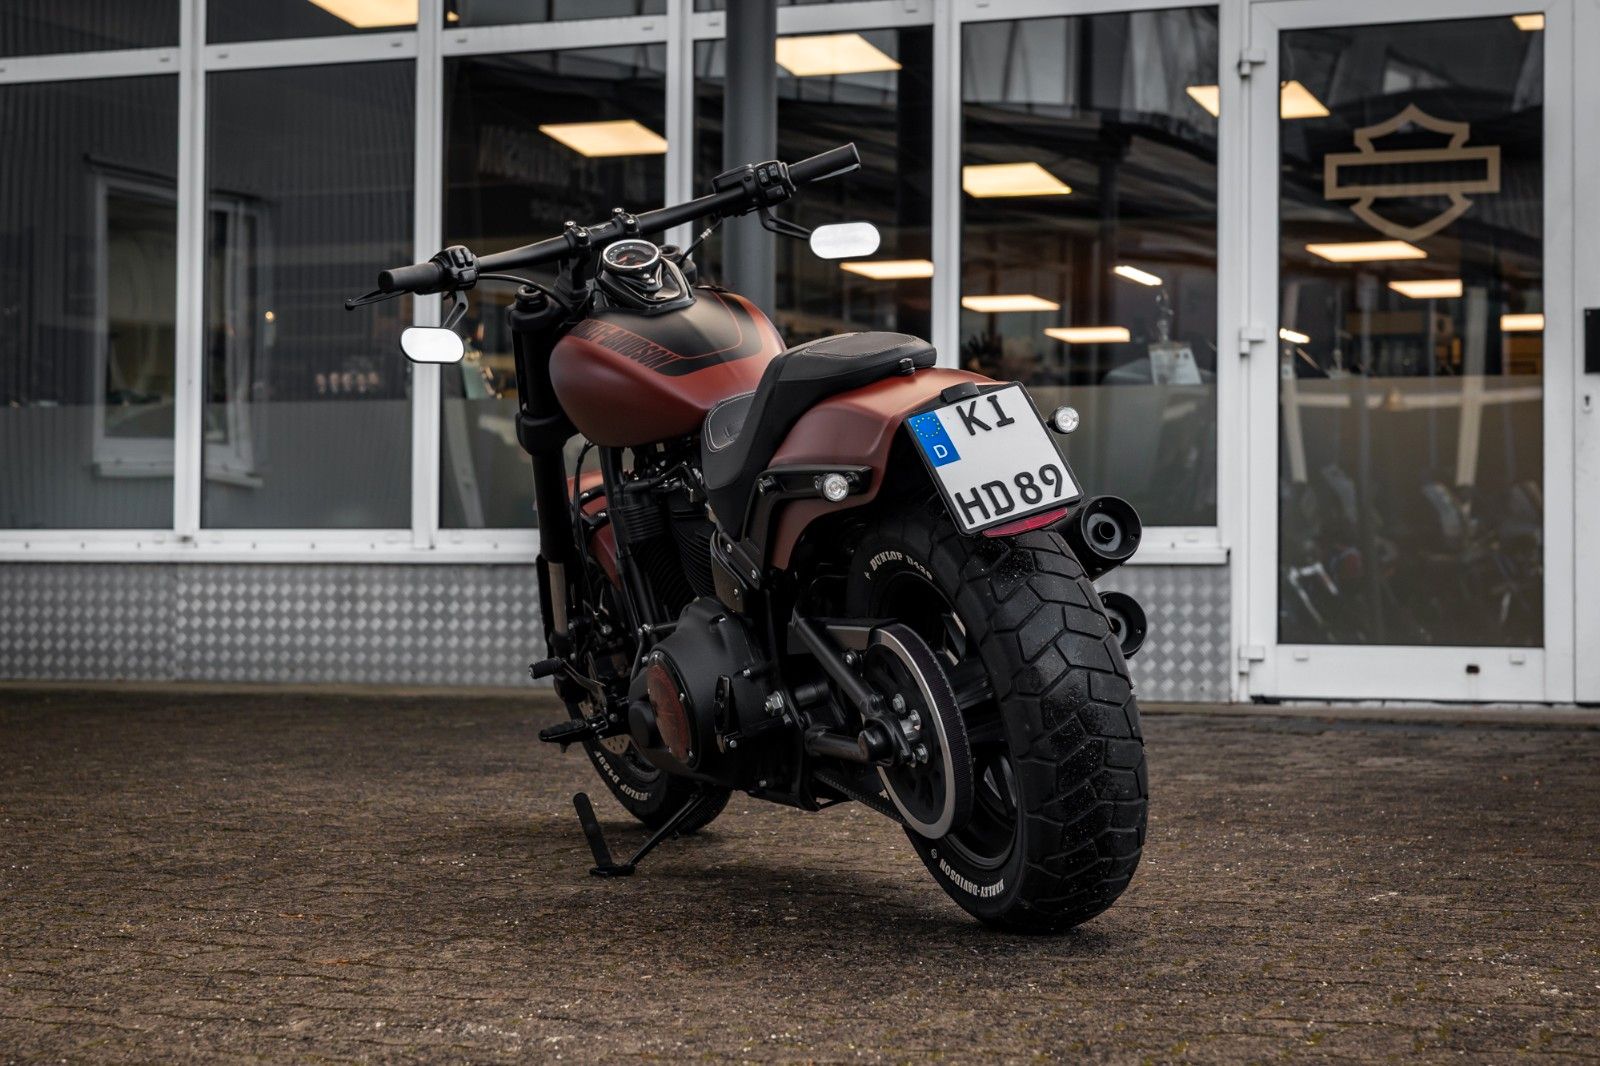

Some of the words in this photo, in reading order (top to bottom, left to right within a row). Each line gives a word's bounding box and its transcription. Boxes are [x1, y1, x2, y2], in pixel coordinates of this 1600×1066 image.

[956, 395, 1015, 436] KI
[933, 444, 948, 458] D
[869, 550, 903, 571] DUNLOP
[939, 858, 1004, 898] HARLEY-DAVIDSON
